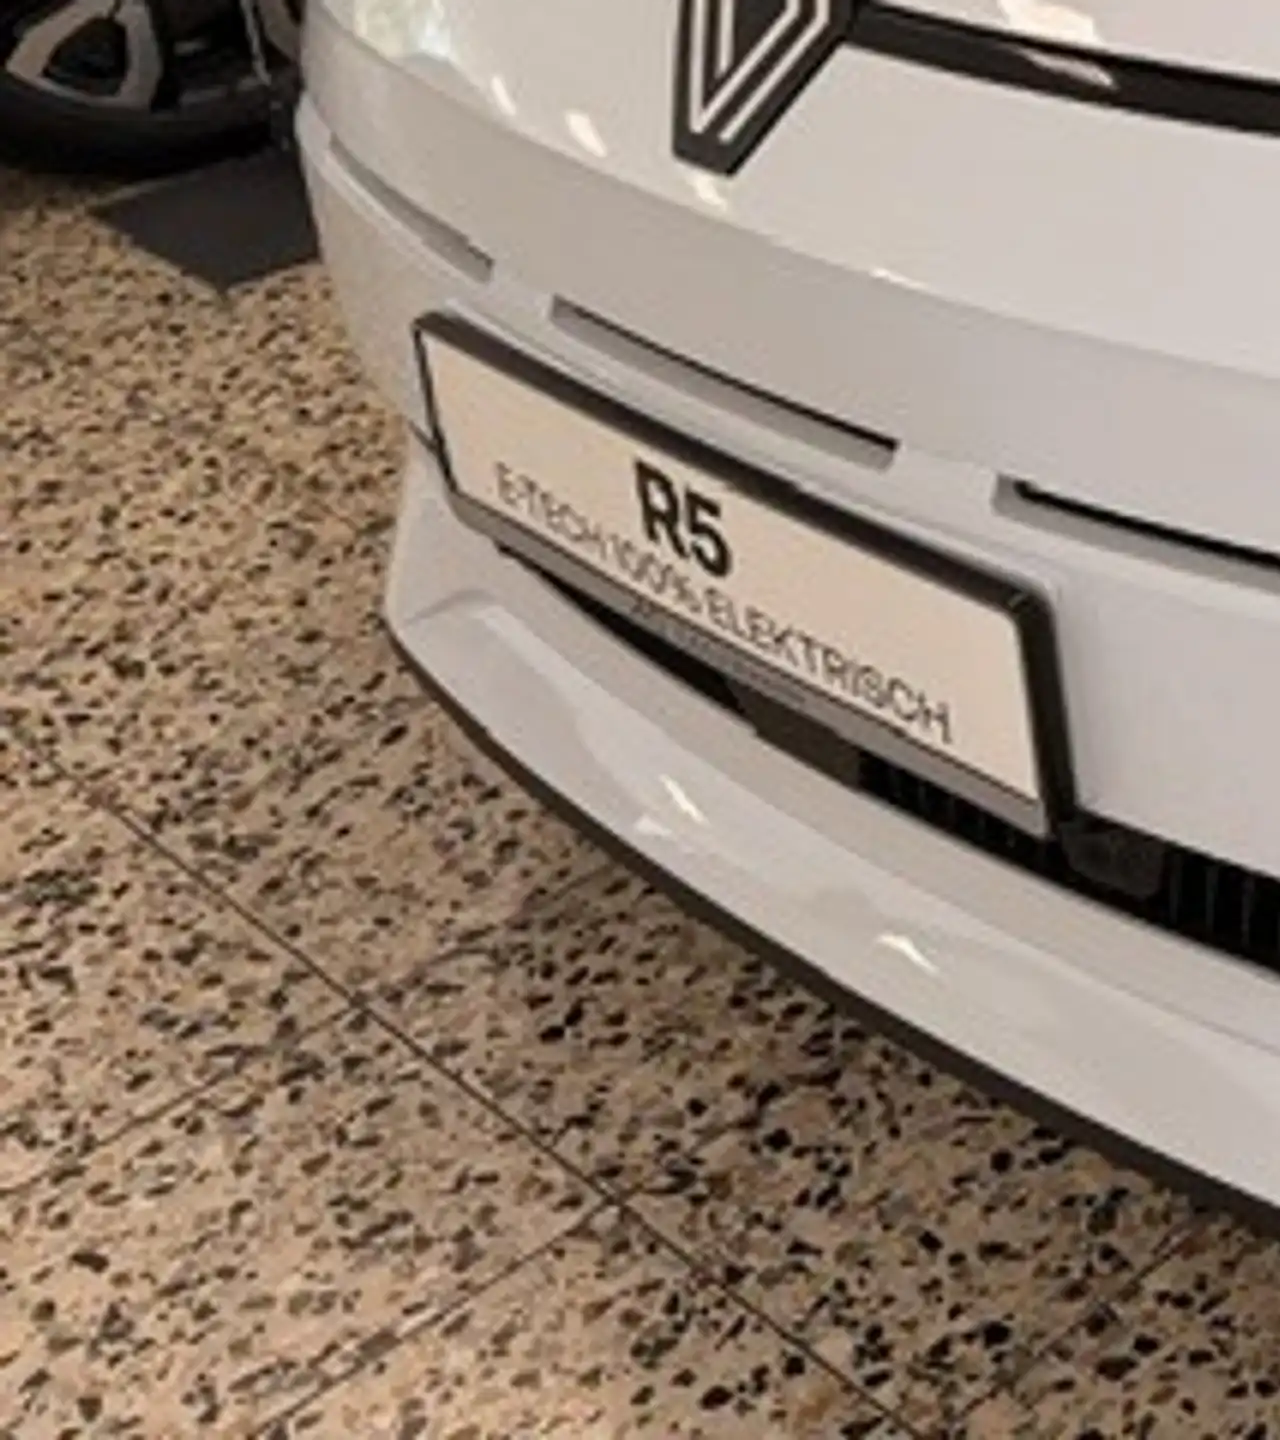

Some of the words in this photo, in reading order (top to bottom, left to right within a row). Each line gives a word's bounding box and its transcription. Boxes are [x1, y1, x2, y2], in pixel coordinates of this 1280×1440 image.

[635, 458, 731, 578] R5
[609, 532, 702, 612] 100%
[704, 586, 953, 744] ELEKTRISCH
